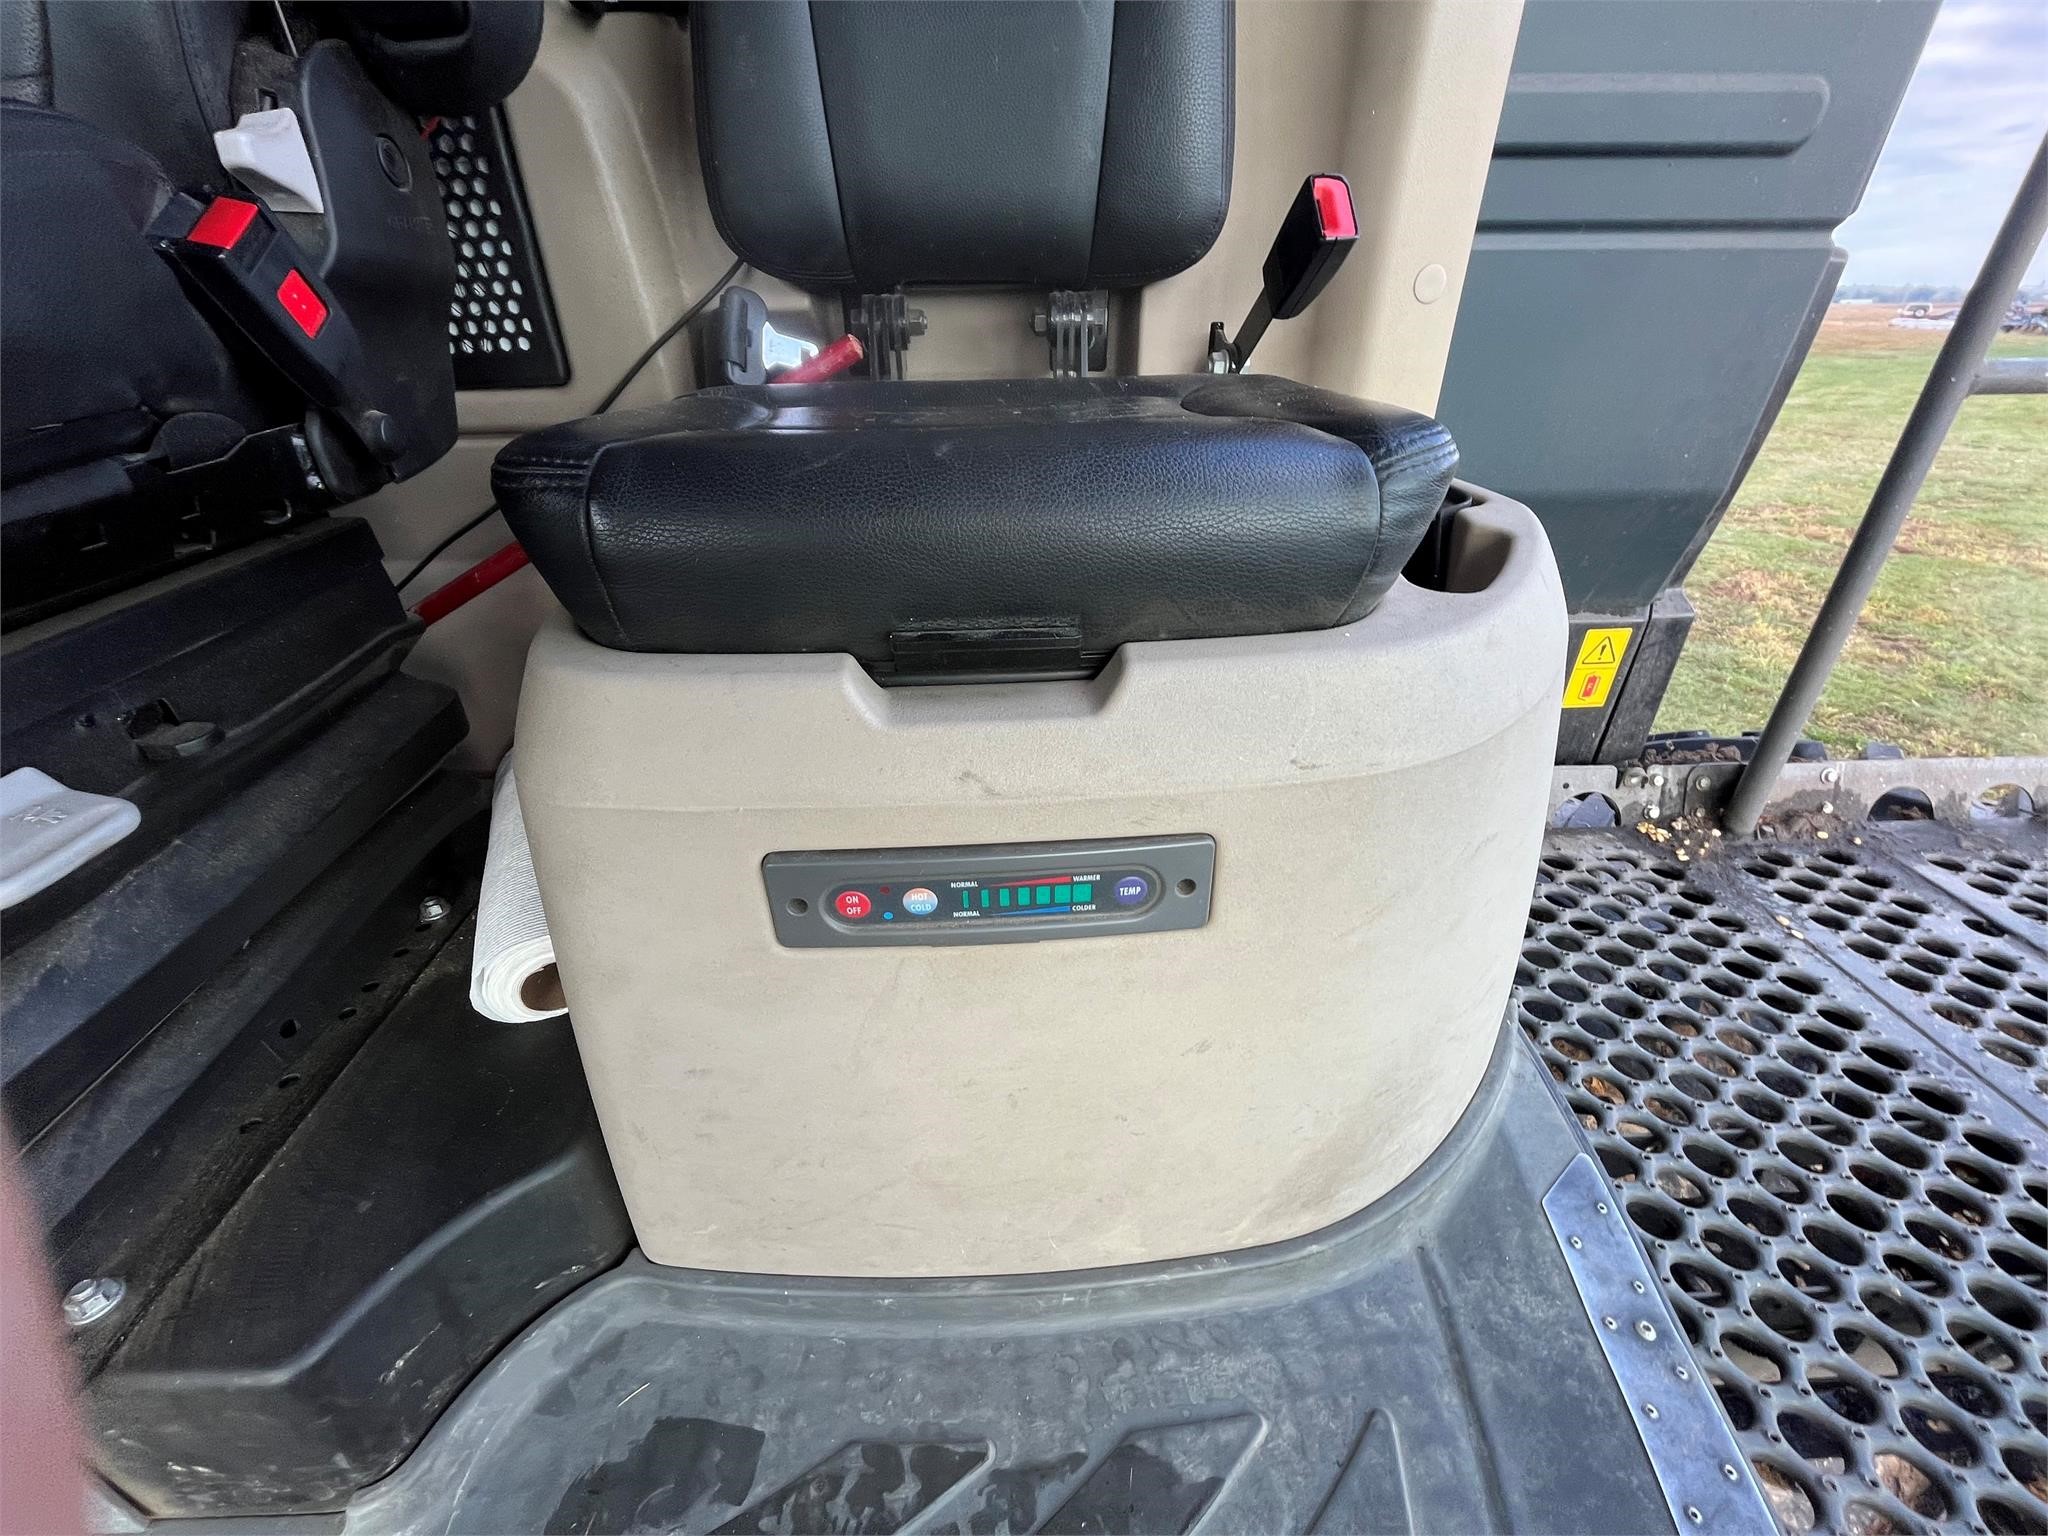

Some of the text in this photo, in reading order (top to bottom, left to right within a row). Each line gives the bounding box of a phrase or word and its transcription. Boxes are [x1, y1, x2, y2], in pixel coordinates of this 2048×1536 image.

[1072, 874, 1101, 882] WARMER
[950, 881, 979, 889] NORMAL
[1119, 887, 1142, 896] TEMP
[845, 896, 859, 904] ON
[911, 893, 929, 901] HOT
[846, 907, 862, 915] OFF
[910, 903, 932, 912] COLD
[1072, 904, 1096, 912] COLDER
[953, 910, 980, 918] NORMAL
